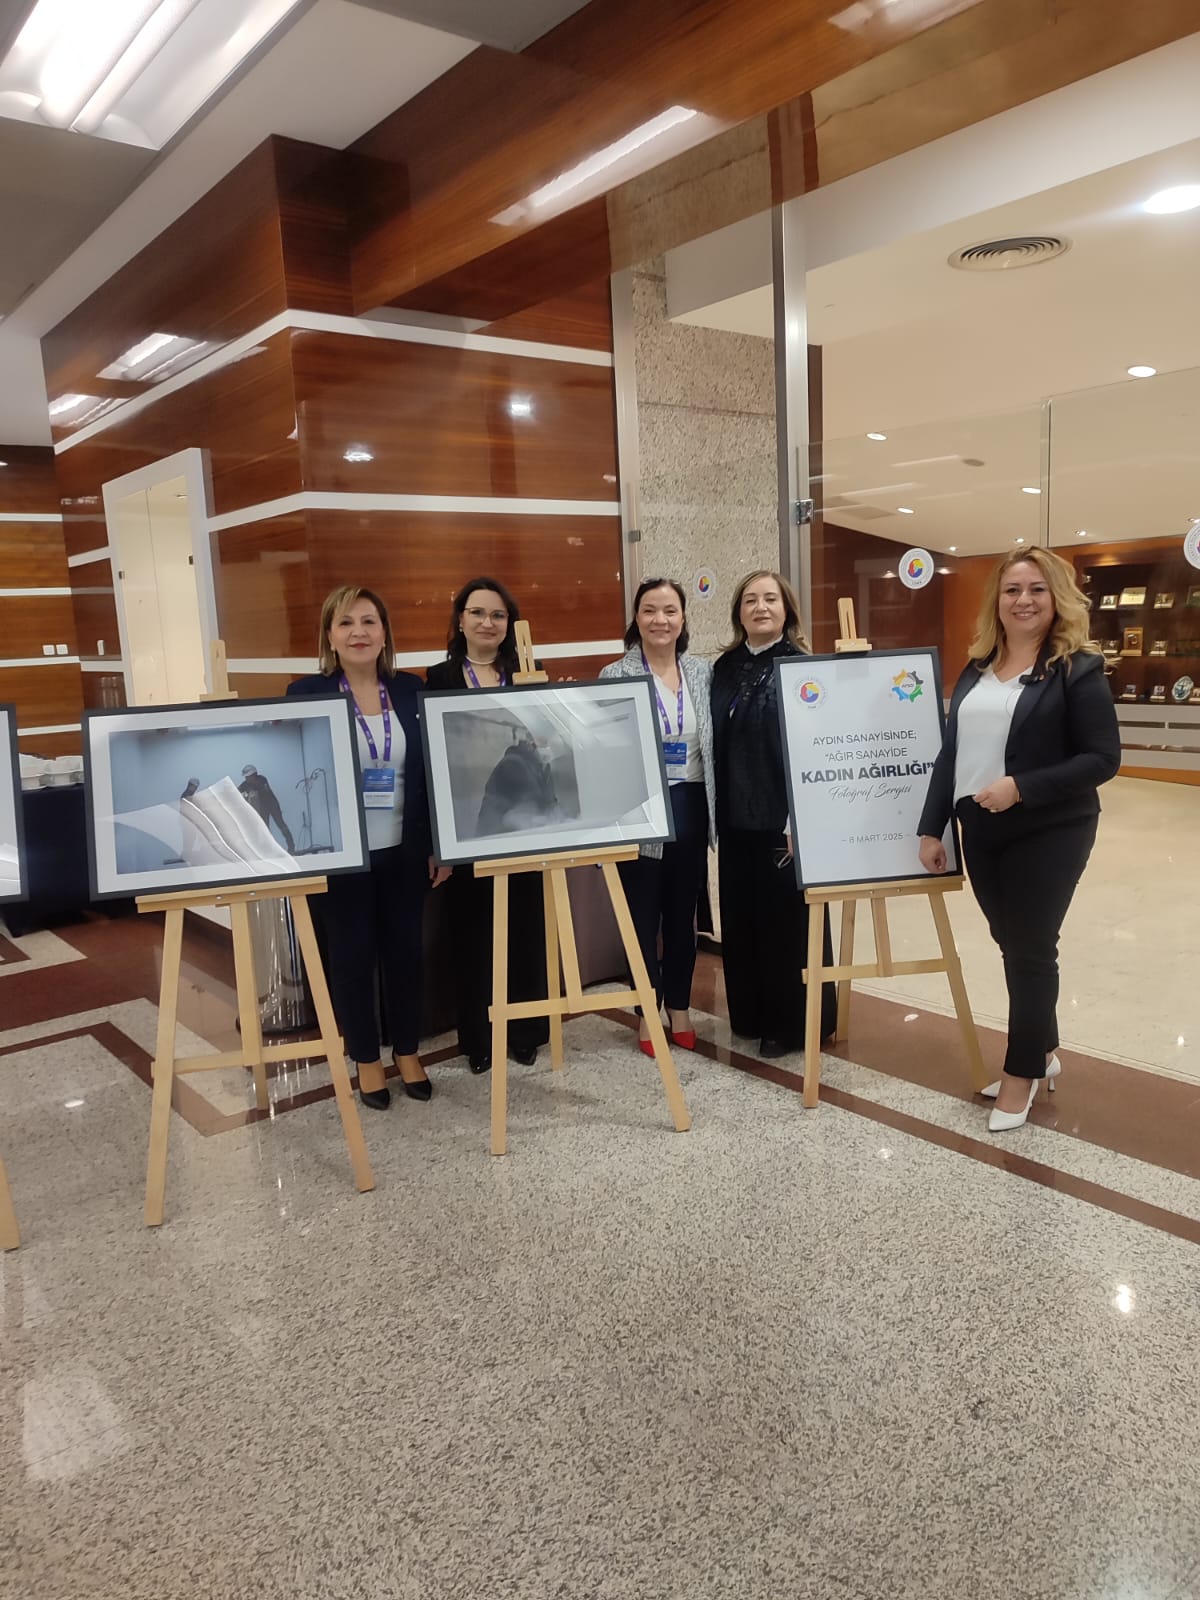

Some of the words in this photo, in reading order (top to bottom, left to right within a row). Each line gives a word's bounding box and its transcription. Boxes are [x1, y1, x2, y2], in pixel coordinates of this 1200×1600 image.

[812, 735, 844, 746] AYDIN
[855, 747, 908, 760] SANAYİDE
[801, 768, 854, 783] KADIN
[857, 833, 880, 842] MART
[882, 832, 903, 841] 2025
